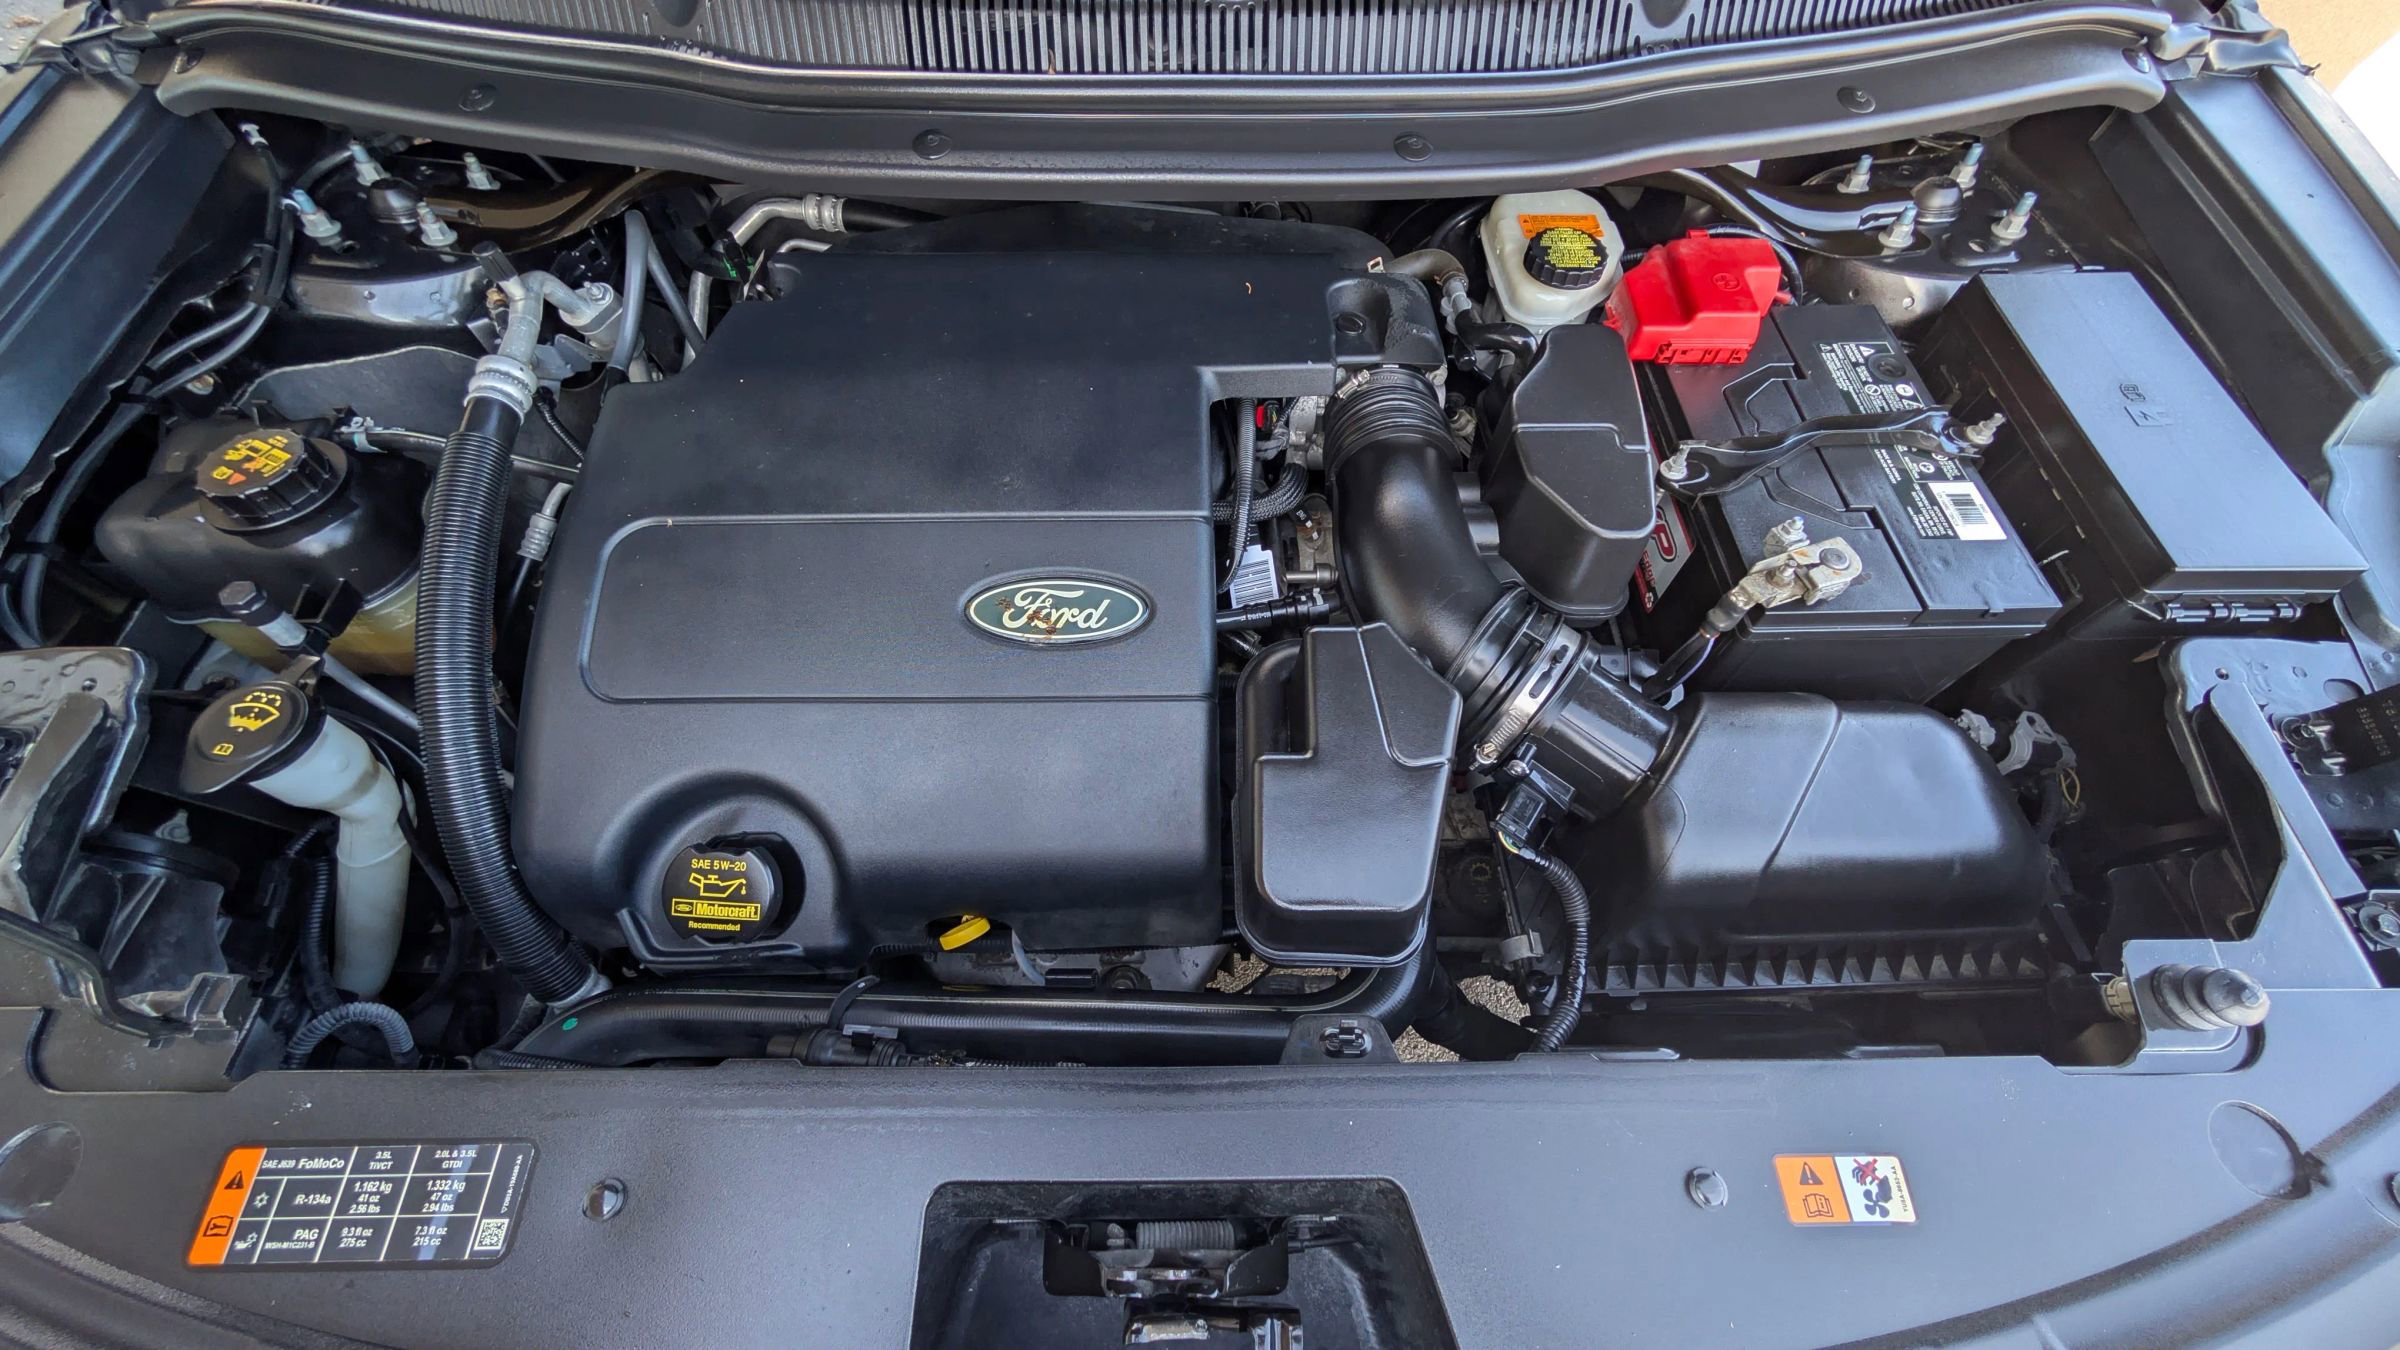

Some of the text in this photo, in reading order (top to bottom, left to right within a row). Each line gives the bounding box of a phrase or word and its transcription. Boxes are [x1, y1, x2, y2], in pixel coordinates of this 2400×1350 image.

[1002, 588, 1111, 629] Ford
[691, 858, 747, 872] SAE 5W-20
[696, 903, 756, 918] Motorcraft
[688, 921, 740, 931] Recommended
[375, 1151, 392, 1159] 3.5L
[435, 1150, 477, 1158] 2.0L & 3.5L
[262, 1160, 277, 1169] SAE
[298, 1158, 345, 1169] FoMoCo
[442, 1160, 463, 1169] GTDI
[354, 1180, 393, 1194] 1.162 kg
[426, 1180, 466, 1192] 1.332 kg
[294, 1194, 332, 1205] R-134a
[358, 1194, 369, 1202] 41
[430, 1193, 442, 1201] 47
[348, 1204, 381, 1214] 2.56 lbs
[422, 1203, 455, 1212] 2.94 lbs
[293, 1229, 319, 1240] PAG
[341, 1227, 356, 1237] 9.3
[362, 1228, 374, 1236] oz
[414, 1226, 448, 1235] 7.3 fl oz
[339, 1238, 367, 1248] 275 cc
[412, 1238, 430, 1247] 215
